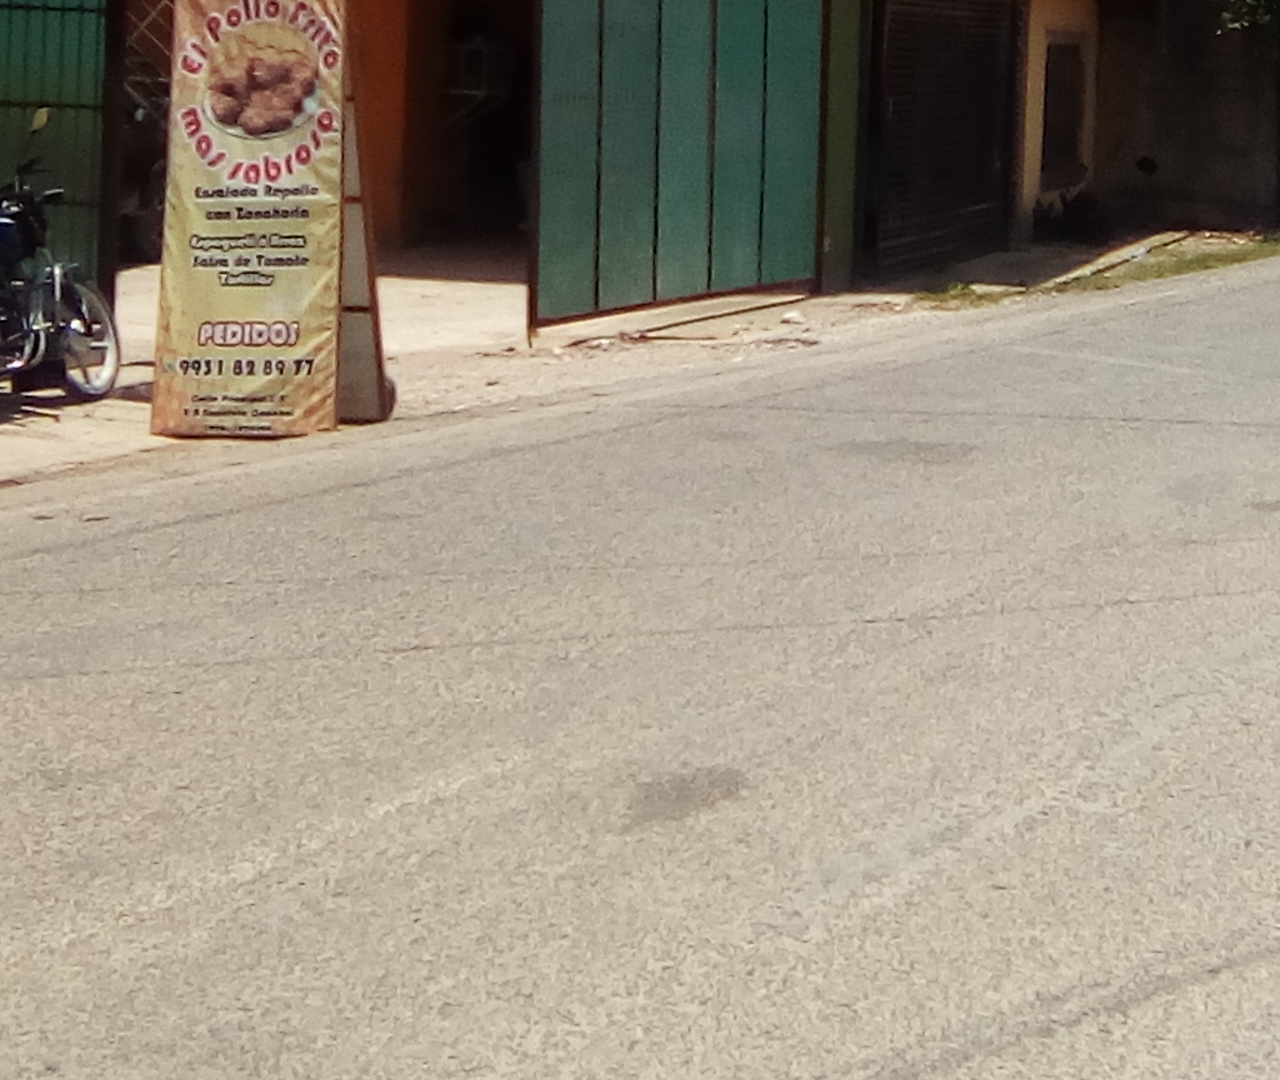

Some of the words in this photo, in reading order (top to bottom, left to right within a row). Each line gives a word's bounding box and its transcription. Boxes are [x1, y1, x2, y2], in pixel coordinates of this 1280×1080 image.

[198, 321, 300, 347] PEDIDOS
[179, 358, 224, 376] 9931
[232, 358, 256, 376] 82
[263, 358, 286, 376] 89
[292, 358, 315, 376] 77
